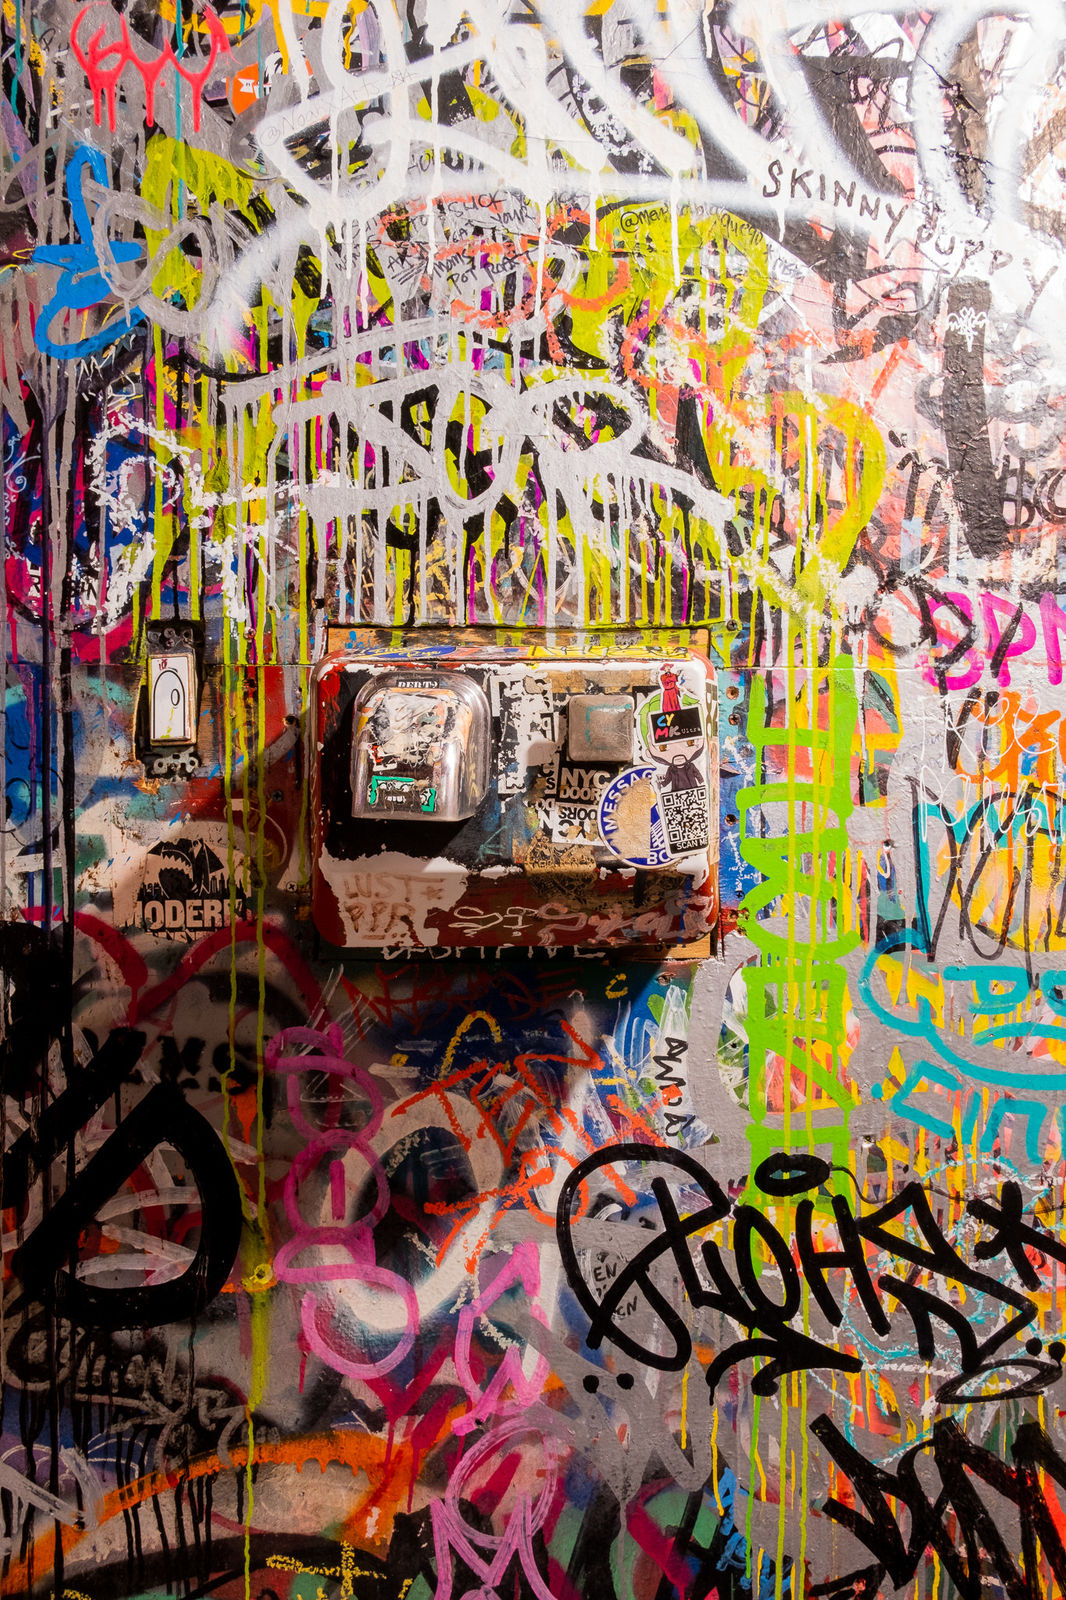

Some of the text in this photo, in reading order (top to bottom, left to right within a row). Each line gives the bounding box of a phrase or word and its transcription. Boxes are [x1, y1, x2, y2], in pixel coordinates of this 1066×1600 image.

[762, 159, 909, 244] SKINNY
[561, 768, 610, 788] NYC
[677, 840, 698, 850] SCAN
